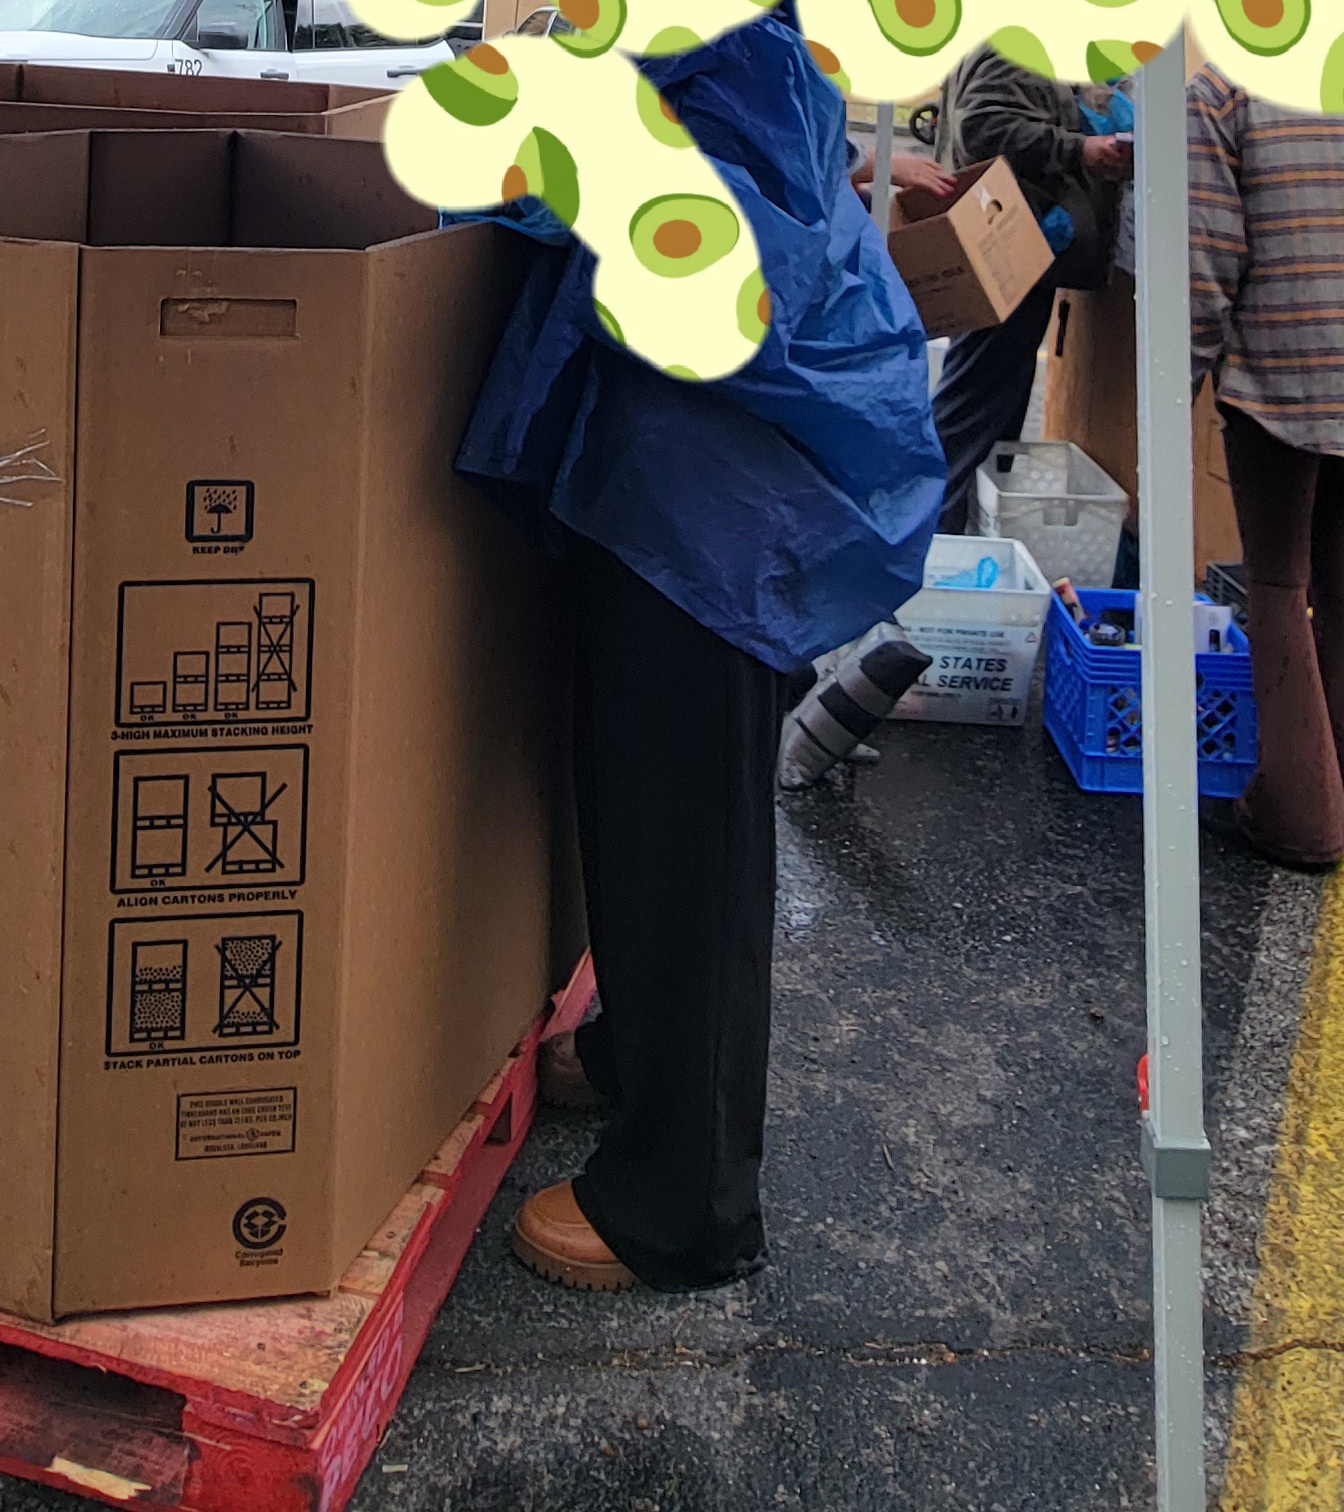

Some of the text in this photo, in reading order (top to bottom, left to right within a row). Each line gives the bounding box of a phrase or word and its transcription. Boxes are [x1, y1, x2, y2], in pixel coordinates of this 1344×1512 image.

[192, 545, 246, 554] KEEP DRY
[939, 655, 1008, 672] STATES
[936, 674, 1015, 692] SERVICE
[111, 724, 314, 741] 3-HIGH MAXIMUM STACKING HEIGHT
[150, 879, 166, 887] OK
[117, 890, 298, 908] ALIGN CARTONS PROPERLY
[149, 1042, 165, 1050] OK
[104, 1050, 302, 1071] STACK PARTIAL CARTONS ON TOP
